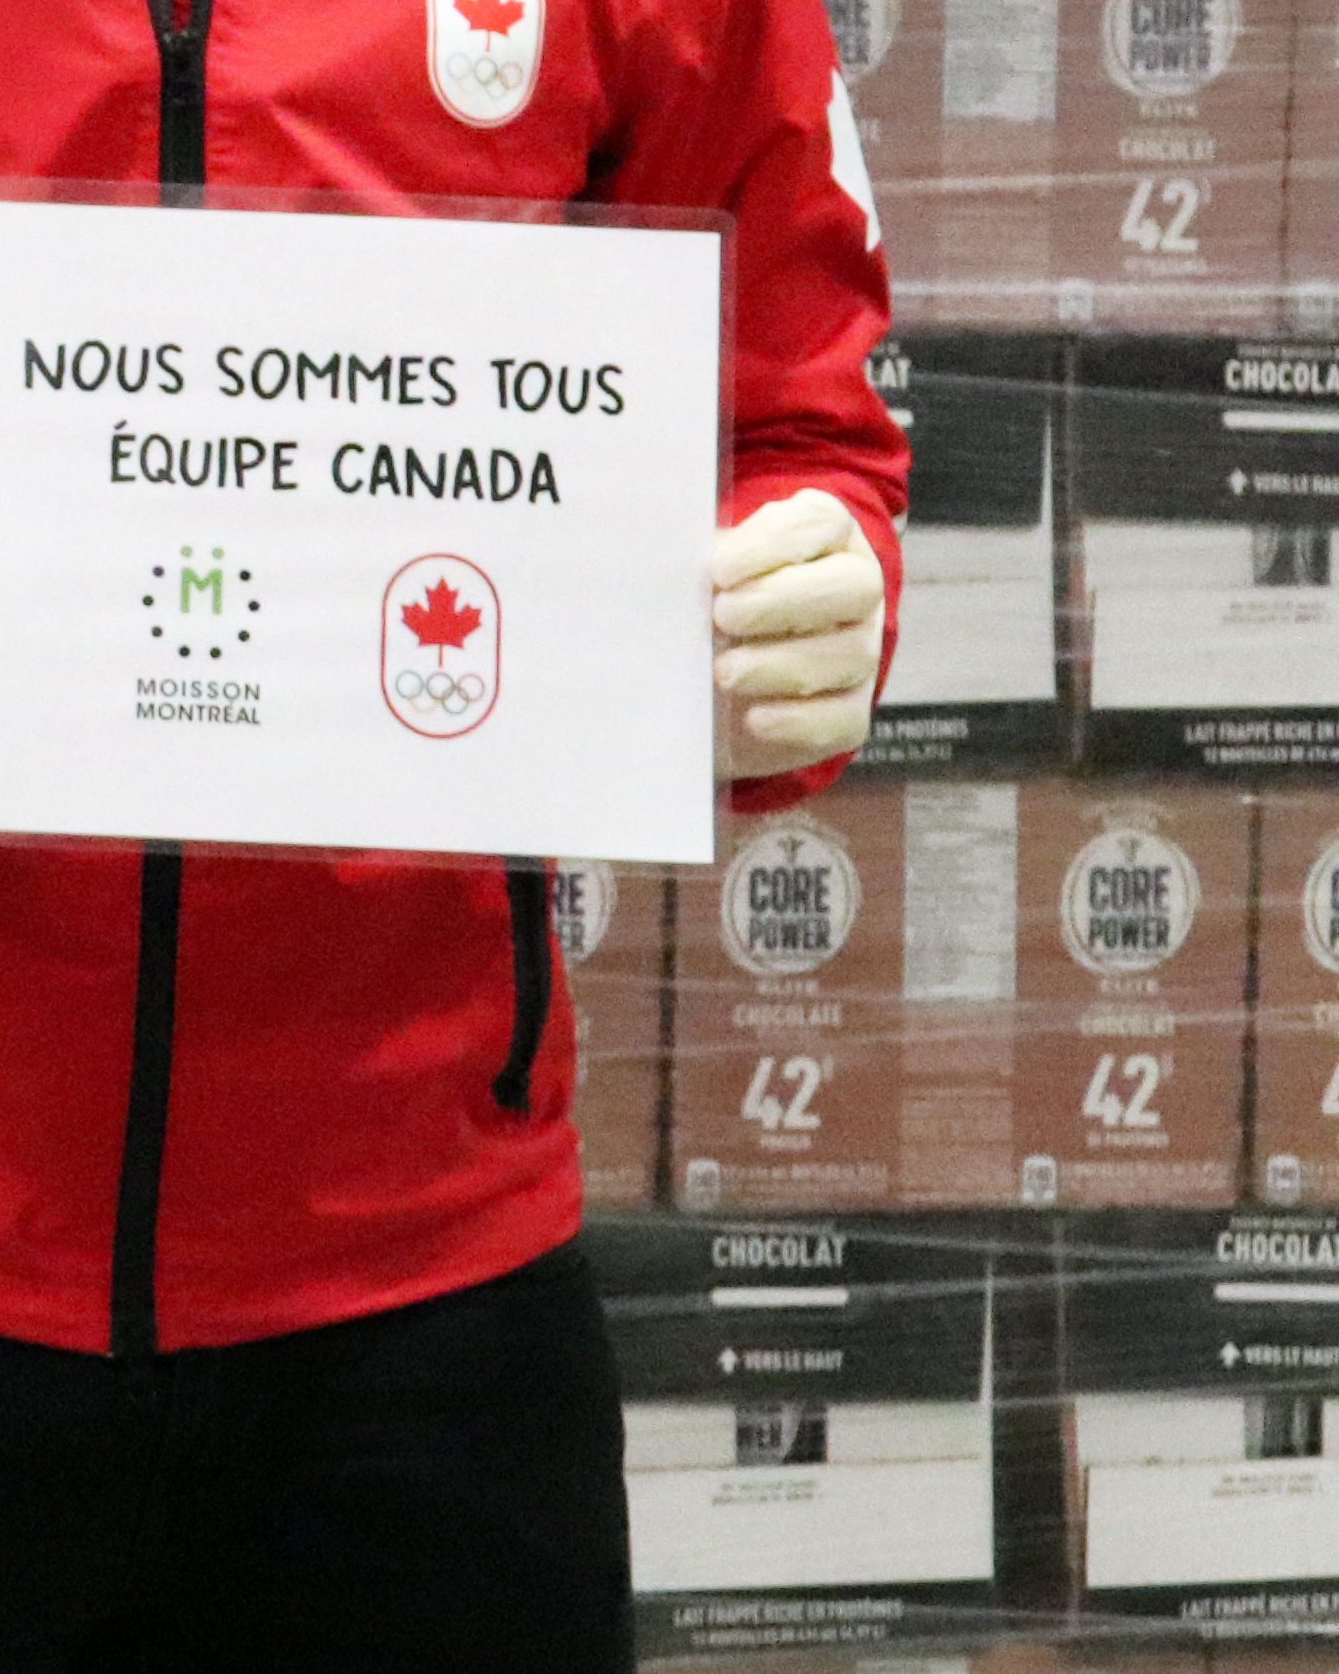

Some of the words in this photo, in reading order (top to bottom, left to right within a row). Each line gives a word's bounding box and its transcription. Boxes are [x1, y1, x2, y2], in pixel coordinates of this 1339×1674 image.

[23, 338, 186, 395] NOUS
[216, 345, 459, 408] SOMMES
[490, 358, 626, 416] TOUS
[110, 420, 299, 492] ÉQUIPE
[331, 442, 562, 506] CANADA
[136, 677, 261, 702] MOISSON
[136, 700, 262, 726] MONTRÉAL
[748, 866, 833, 914] CORE
[1088, 865, 1172, 913] CORE
[748, 917, 833, 950] POWER
[1088, 916, 1171, 949] POWER
[712, 1234, 848, 1268] CHOCOLAT
[743, 1348, 782, 1372] VERS
[784, 1349, 801, 1372] LE
[803, 1348, 844, 1371] HAUT
